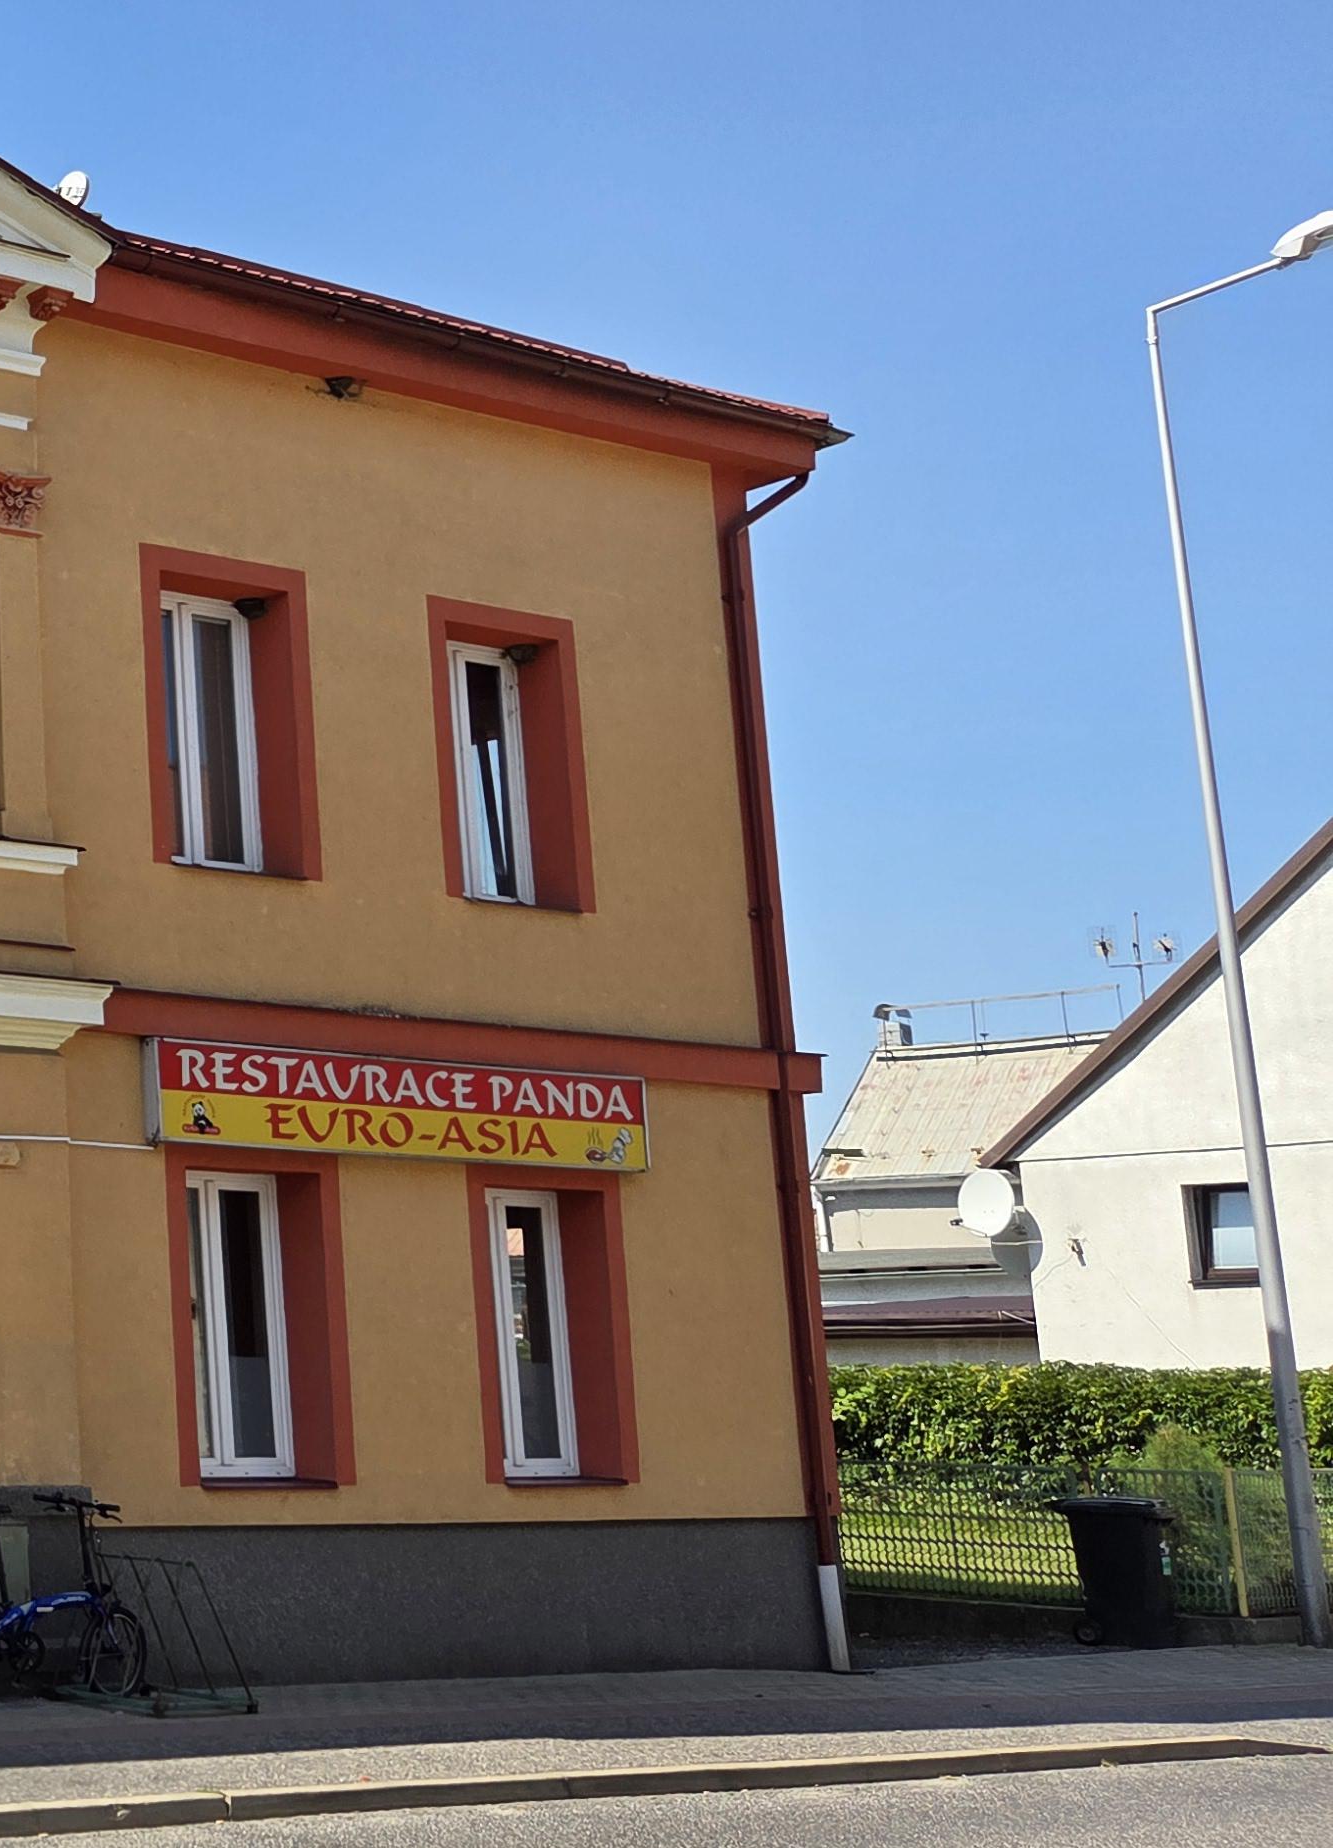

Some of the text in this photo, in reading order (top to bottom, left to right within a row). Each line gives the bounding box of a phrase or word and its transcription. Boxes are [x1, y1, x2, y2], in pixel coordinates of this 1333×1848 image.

[175, 1048, 477, 1110] RESTAURACE
[487, 1075, 634, 1121] PANDA
[264, 1102, 558, 1158] EURO-ASIA
